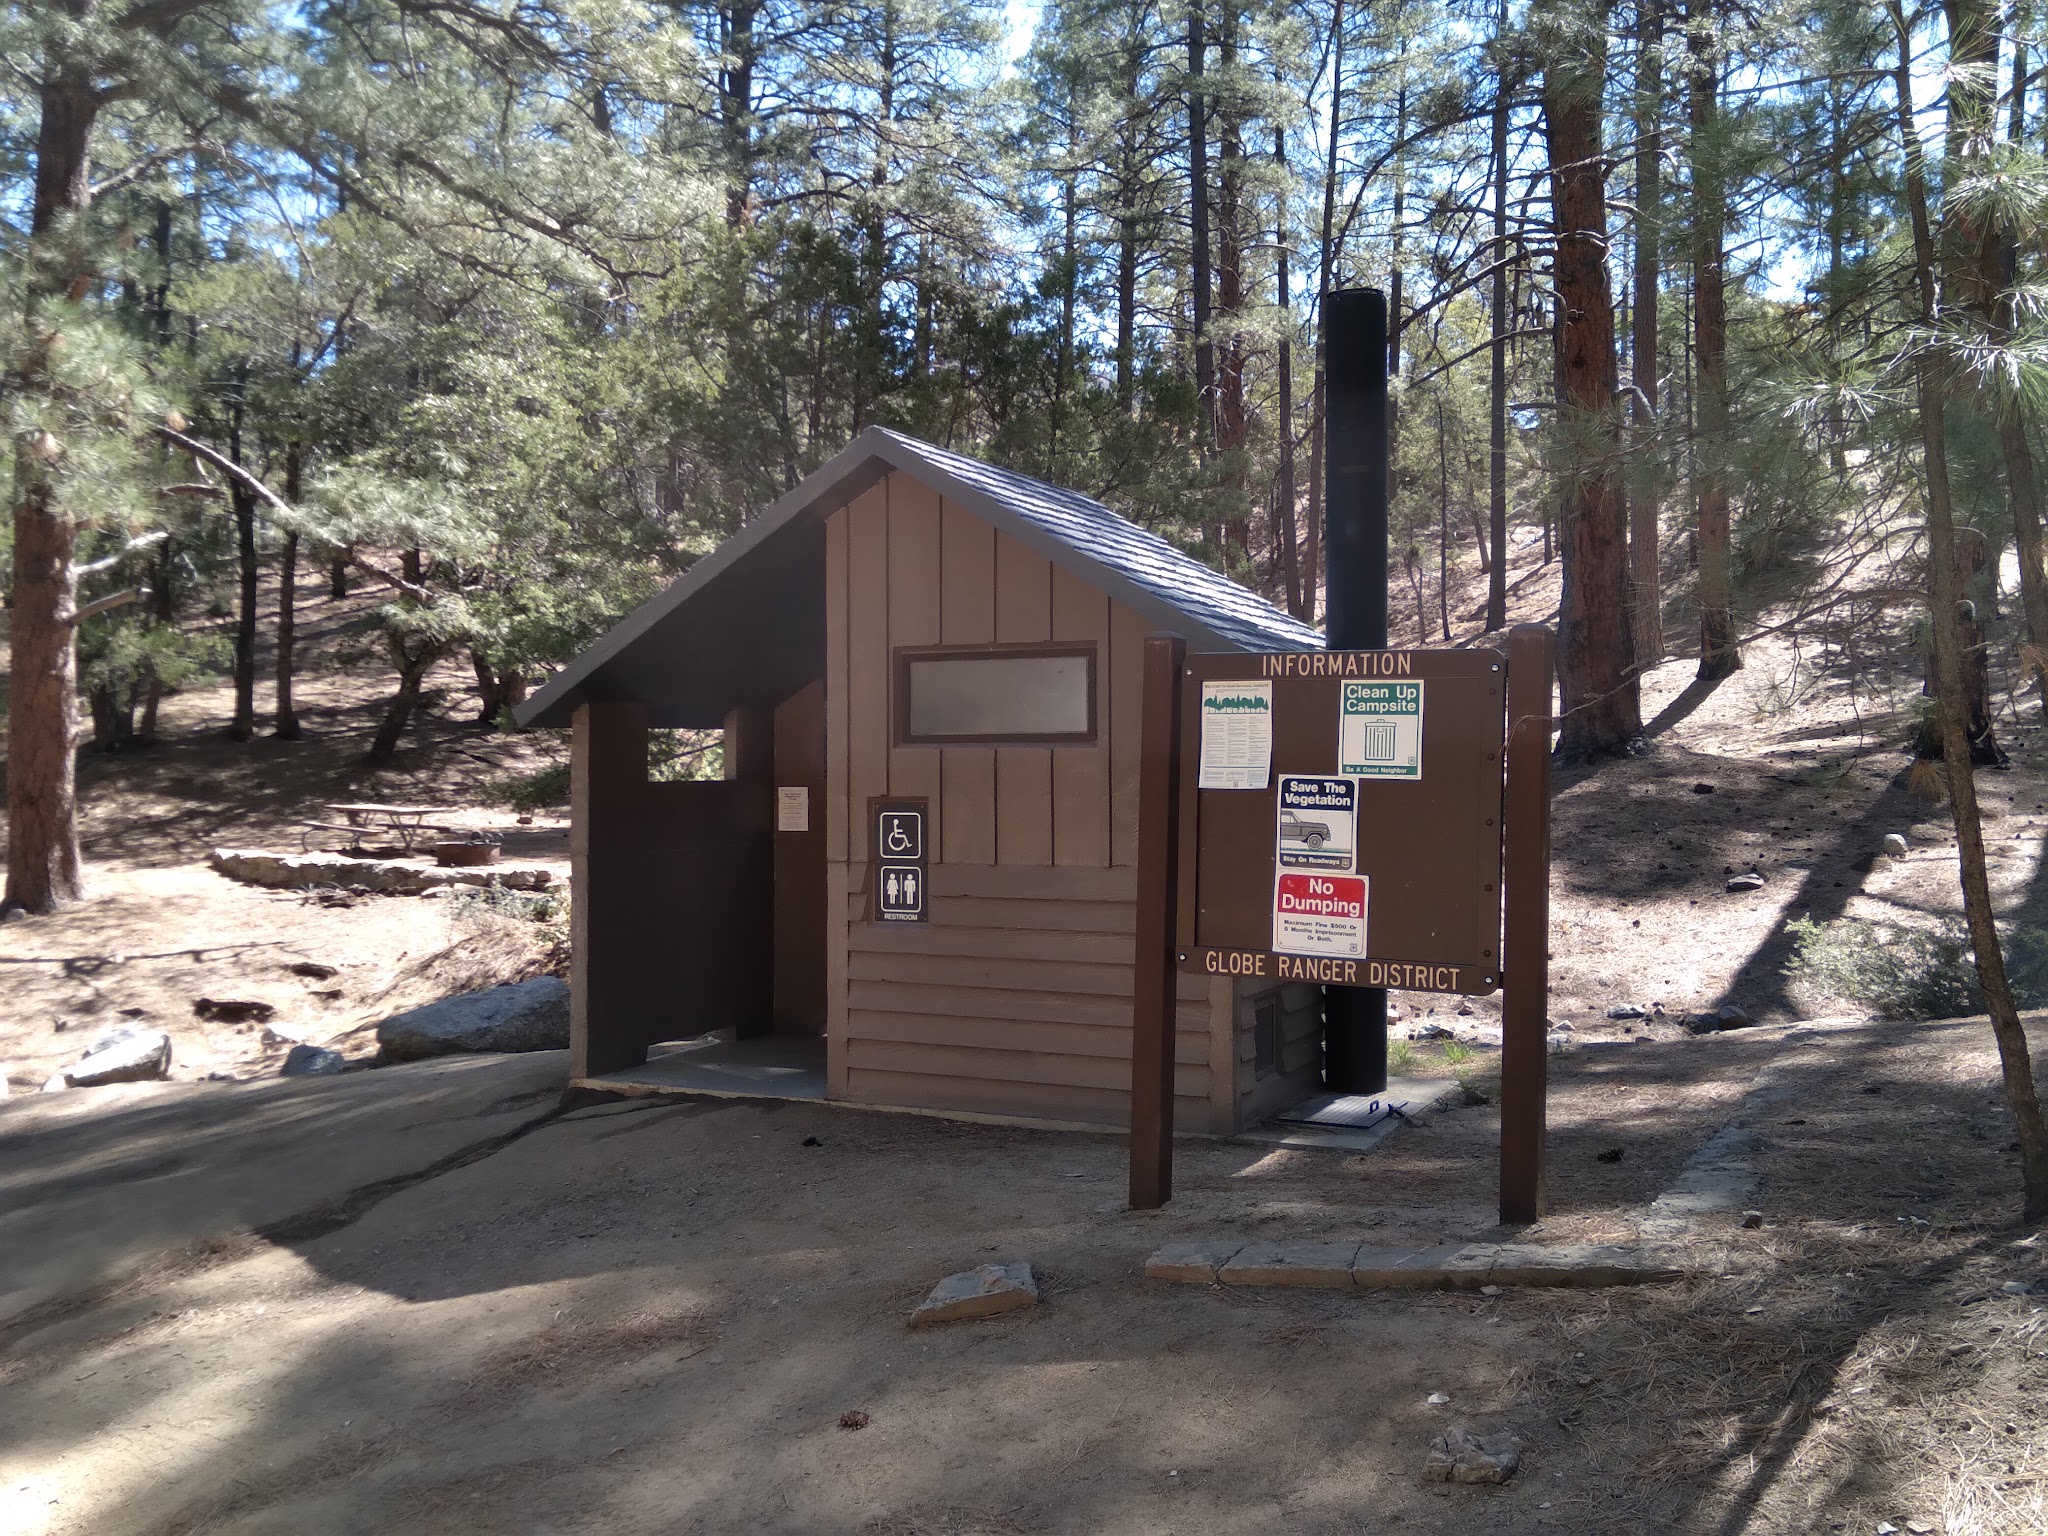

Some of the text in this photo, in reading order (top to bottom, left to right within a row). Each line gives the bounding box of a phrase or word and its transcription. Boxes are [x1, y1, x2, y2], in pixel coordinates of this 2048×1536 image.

[1262, 652, 1411, 676] INFORMATION
[1346, 685, 1417, 701] Clean Up
[1346, 699, 1417, 714] Campsite
[1290, 781, 1347, 794] Save The
[1284, 793, 1351, 807] Vegetation
[1282, 855, 1297, 863] Stay
[1308, 857, 1340, 866] Roadways
[1309, 878, 1334, 895] No
[1281, 893, 1361, 918] Dumping
[884, 913, 918, 921] RESTROOM
[1283, 919, 1313, 927] Maximum
[1330, 922, 1347, 930] $500
[1315, 928, 1357, 938] Imprisonment
[1205, 950, 1460, 991] GLOBE RANGER DISTRICT
